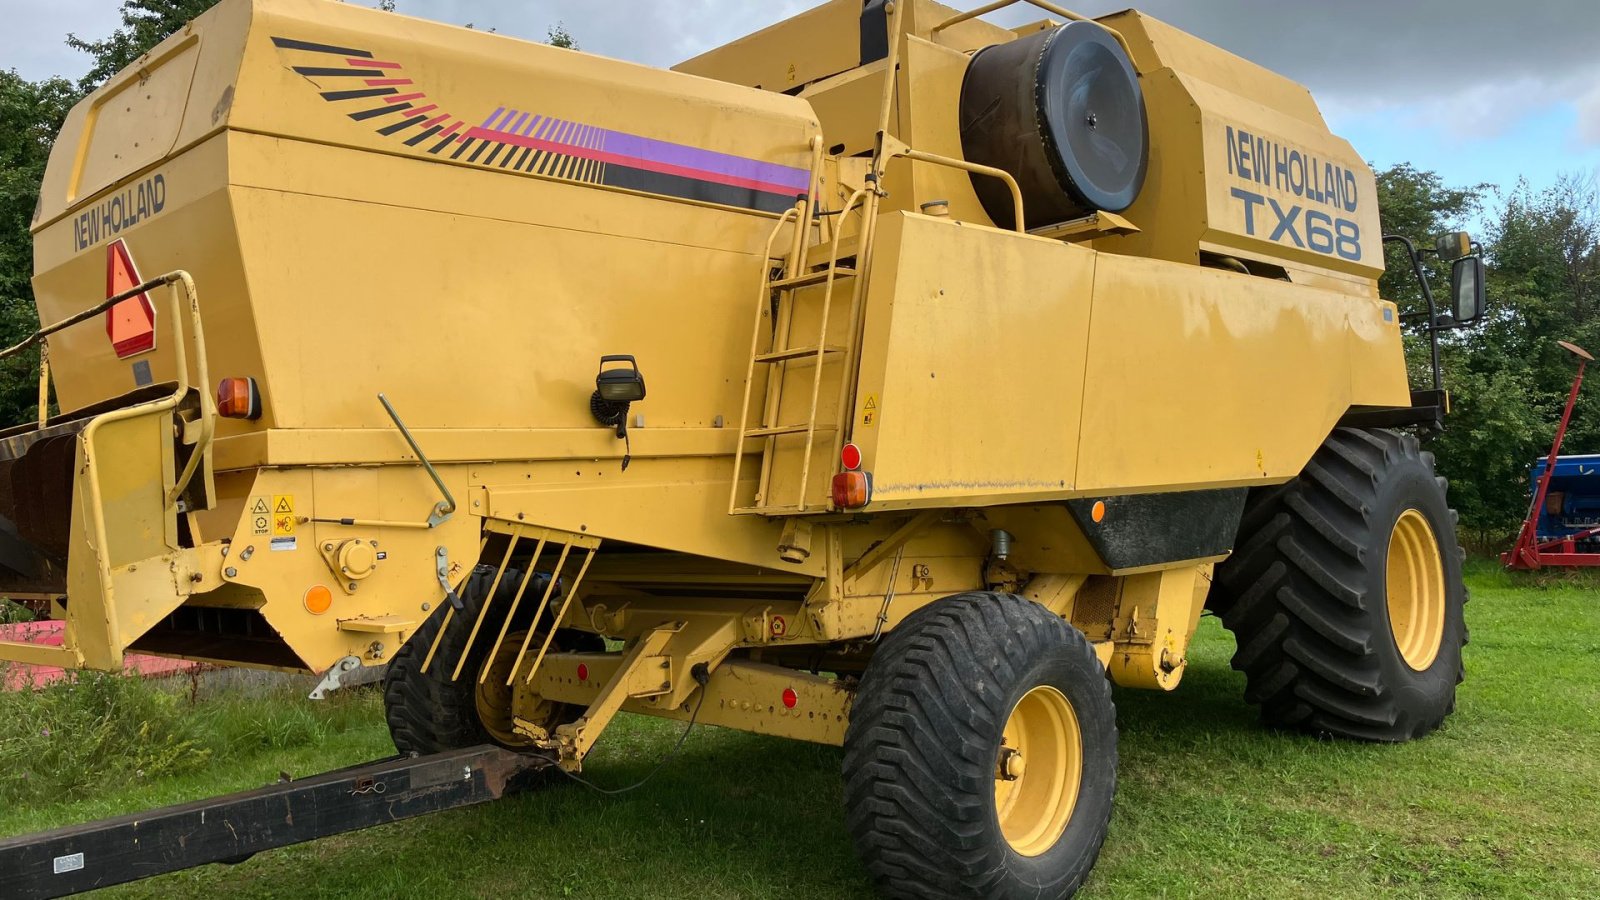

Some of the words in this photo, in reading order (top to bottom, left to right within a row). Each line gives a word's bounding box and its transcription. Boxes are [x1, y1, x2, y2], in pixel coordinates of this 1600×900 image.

[1226, 125, 1270, 187] NEW
[1274, 143, 1357, 213] HOLLAND
[74, 206, 99, 253] NEW
[102, 173, 166, 239] HOLLAND
[1230, 186, 1361, 261] TX68
